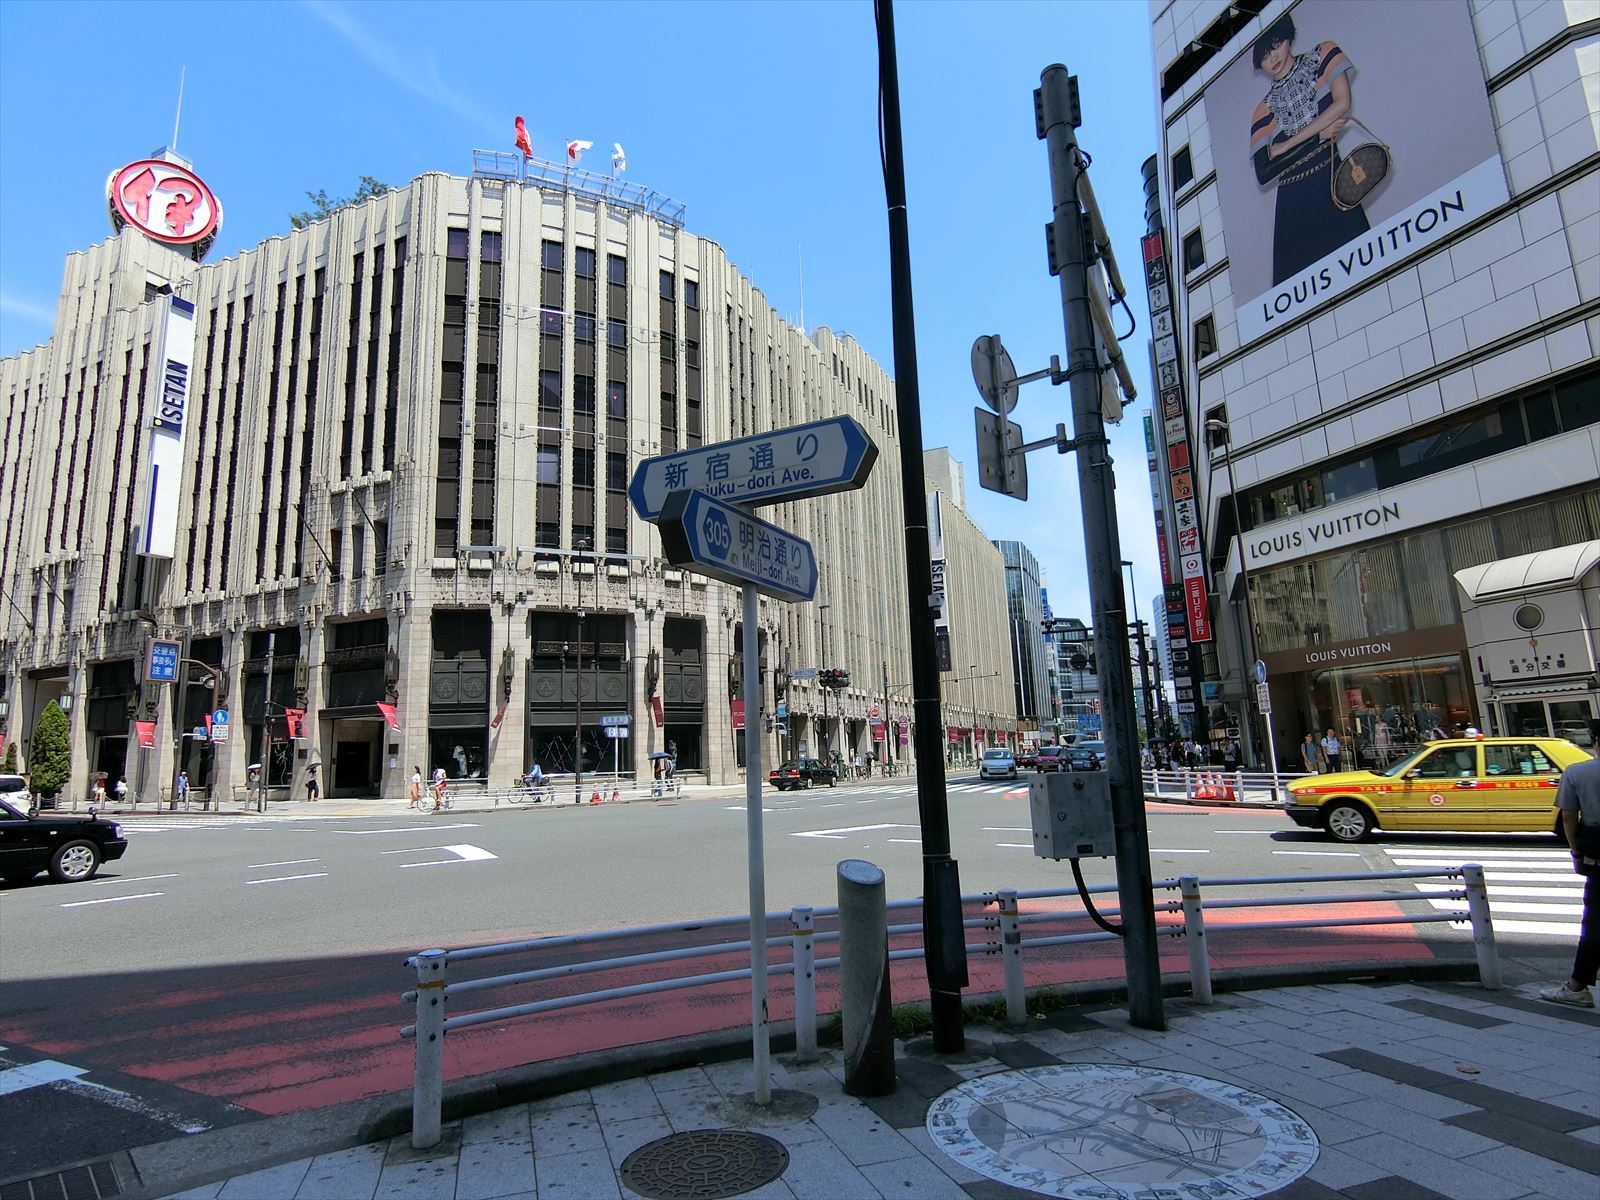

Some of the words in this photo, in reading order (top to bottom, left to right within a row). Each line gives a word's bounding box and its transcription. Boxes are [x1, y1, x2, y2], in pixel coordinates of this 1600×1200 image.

[1262, 268, 1332, 323] LOUIS
[1338, 190, 1465, 277] VUITTON
[153, 358, 188, 436] ISETAN
[665, 433, 819, 489] 新宿通り
[782, 466, 815, 484] Ave.
[705, 517, 729, 549] 305
[739, 520, 802, 570] 明治通り
[1250, 531, 1302, 559] LOUIS
[1308, 502, 1400, 543] VUITTON
[742, 552, 784, 581] Meiji-dori
[785, 569, 802, 589] Ave.
[931, 559, 945, 600] ISETA
[152, 667, 174, 676] 注意
[1305, 649, 1337, 663] LOUIS
[1339, 642, 1391, 658] VUITTON
